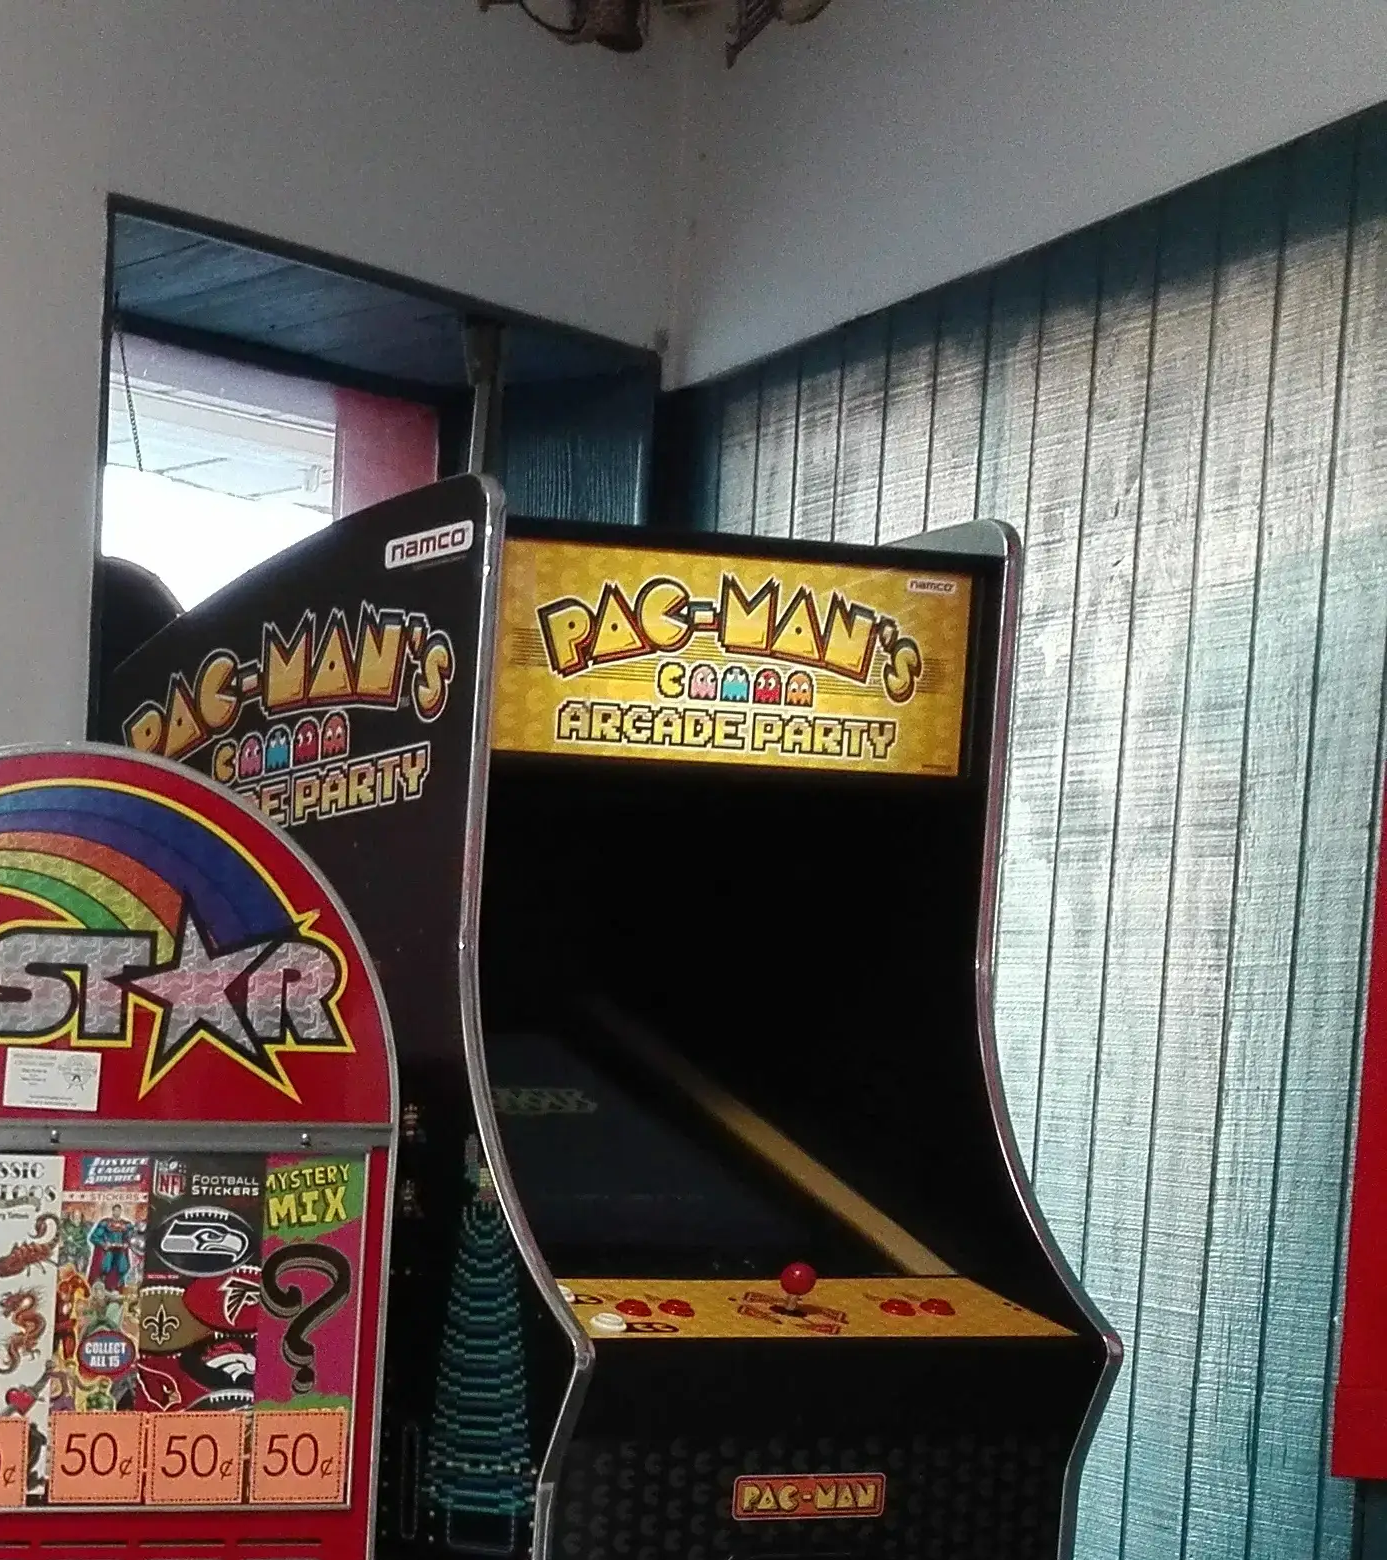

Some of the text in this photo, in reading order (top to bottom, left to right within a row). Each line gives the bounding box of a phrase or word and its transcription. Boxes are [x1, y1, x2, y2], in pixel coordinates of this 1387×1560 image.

[391, 527, 466, 562] namco
[536, 572, 924, 703] PAC-MAN'S
[556, 700, 899, 759] ARCADE PARTY
[292, 742, 431, 827] PARTY
[159, 1173, 186, 1198] NFL
[191, 1186, 259, 1196] STICKERS
[192, 1174, 259, 1187] FOOTBALL
[268, 1186, 348, 1230] MIX
[85, 1341, 126, 1355] COLLECT
[90, 1354, 120, 1367] ALL 15
[59, 1432, 133, 1480] 50¢
[160, 1433, 234, 1481] 50¢
[261, 1432, 334, 1480] 50¢
[741, 1481, 877, 1513] PAC-MAN
